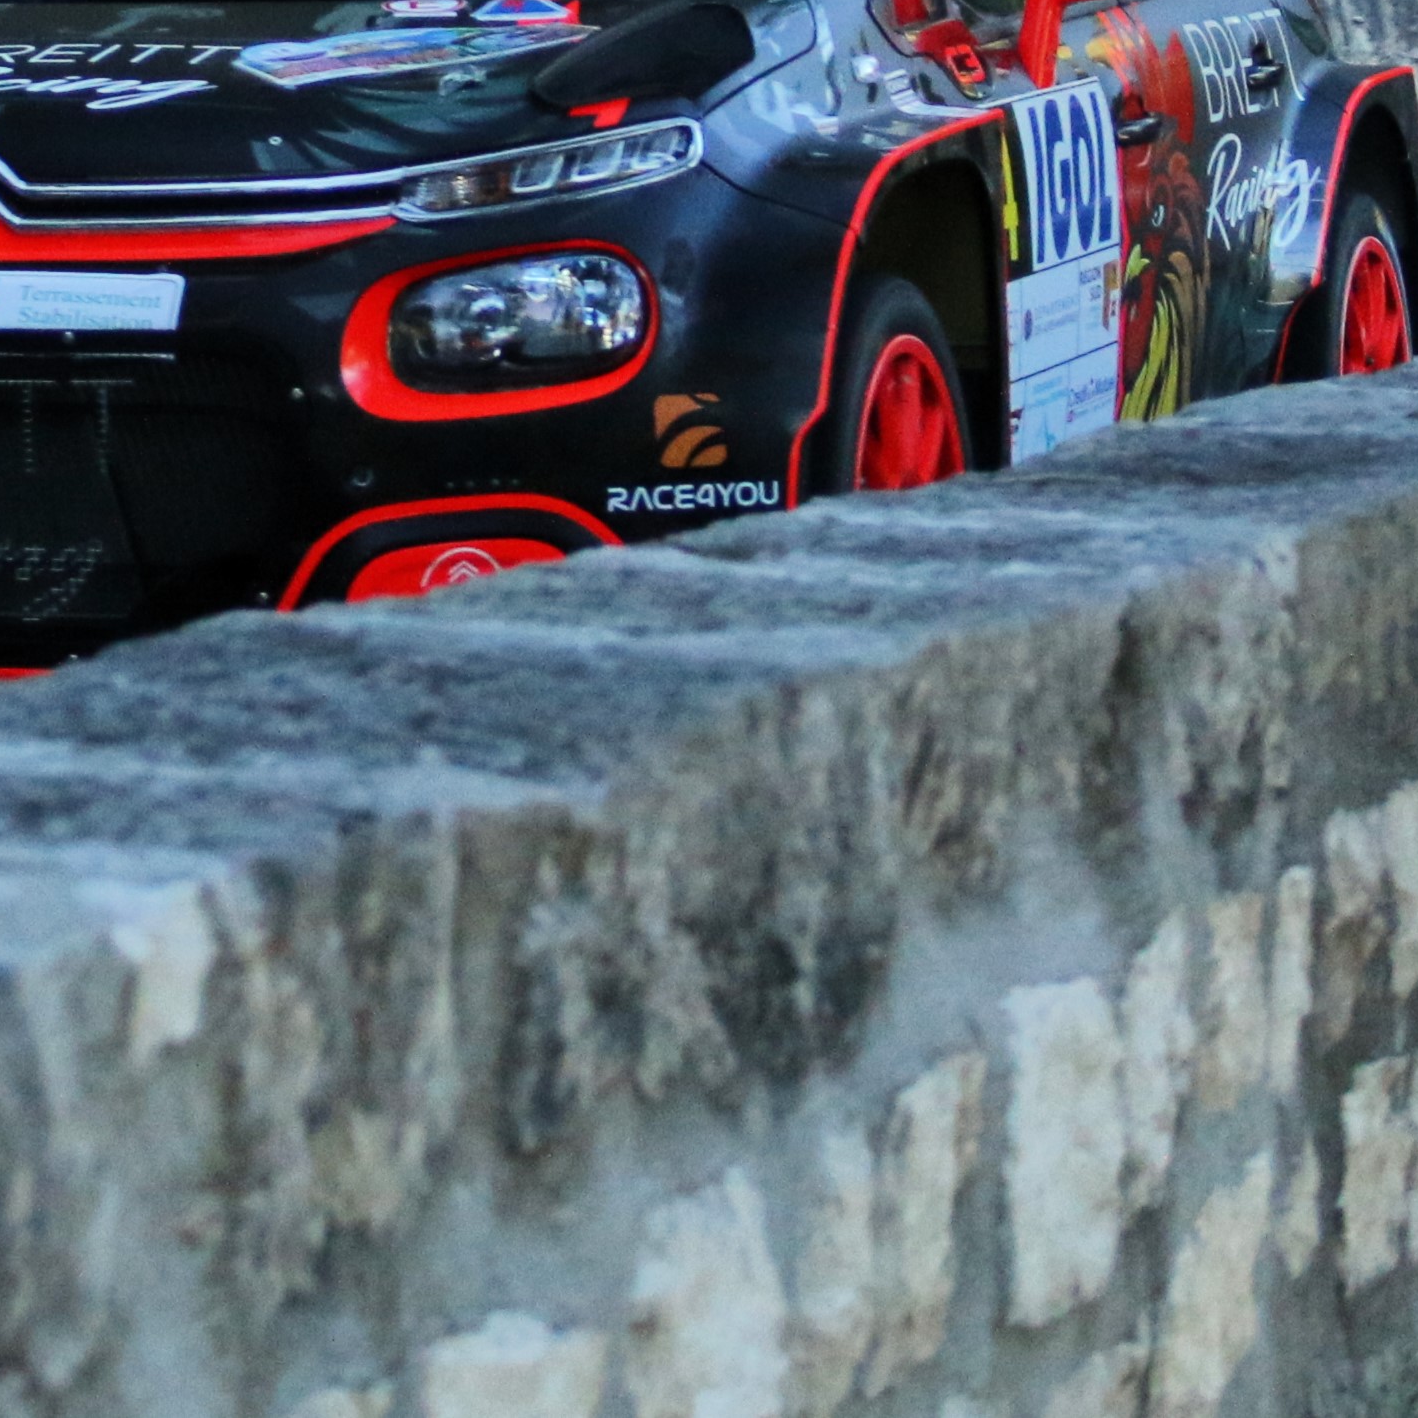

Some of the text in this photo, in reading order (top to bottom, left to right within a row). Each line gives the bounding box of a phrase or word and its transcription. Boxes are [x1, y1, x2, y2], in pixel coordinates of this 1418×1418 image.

[1028, 92, 1112, 264] IGOL
[1206, 132, 1322, 252] Racing
[20, 285, 161, 309] Terrassement
[18, 306, 154, 329] Stabilisation
[607, 480, 780, 513] RACE4YOU
